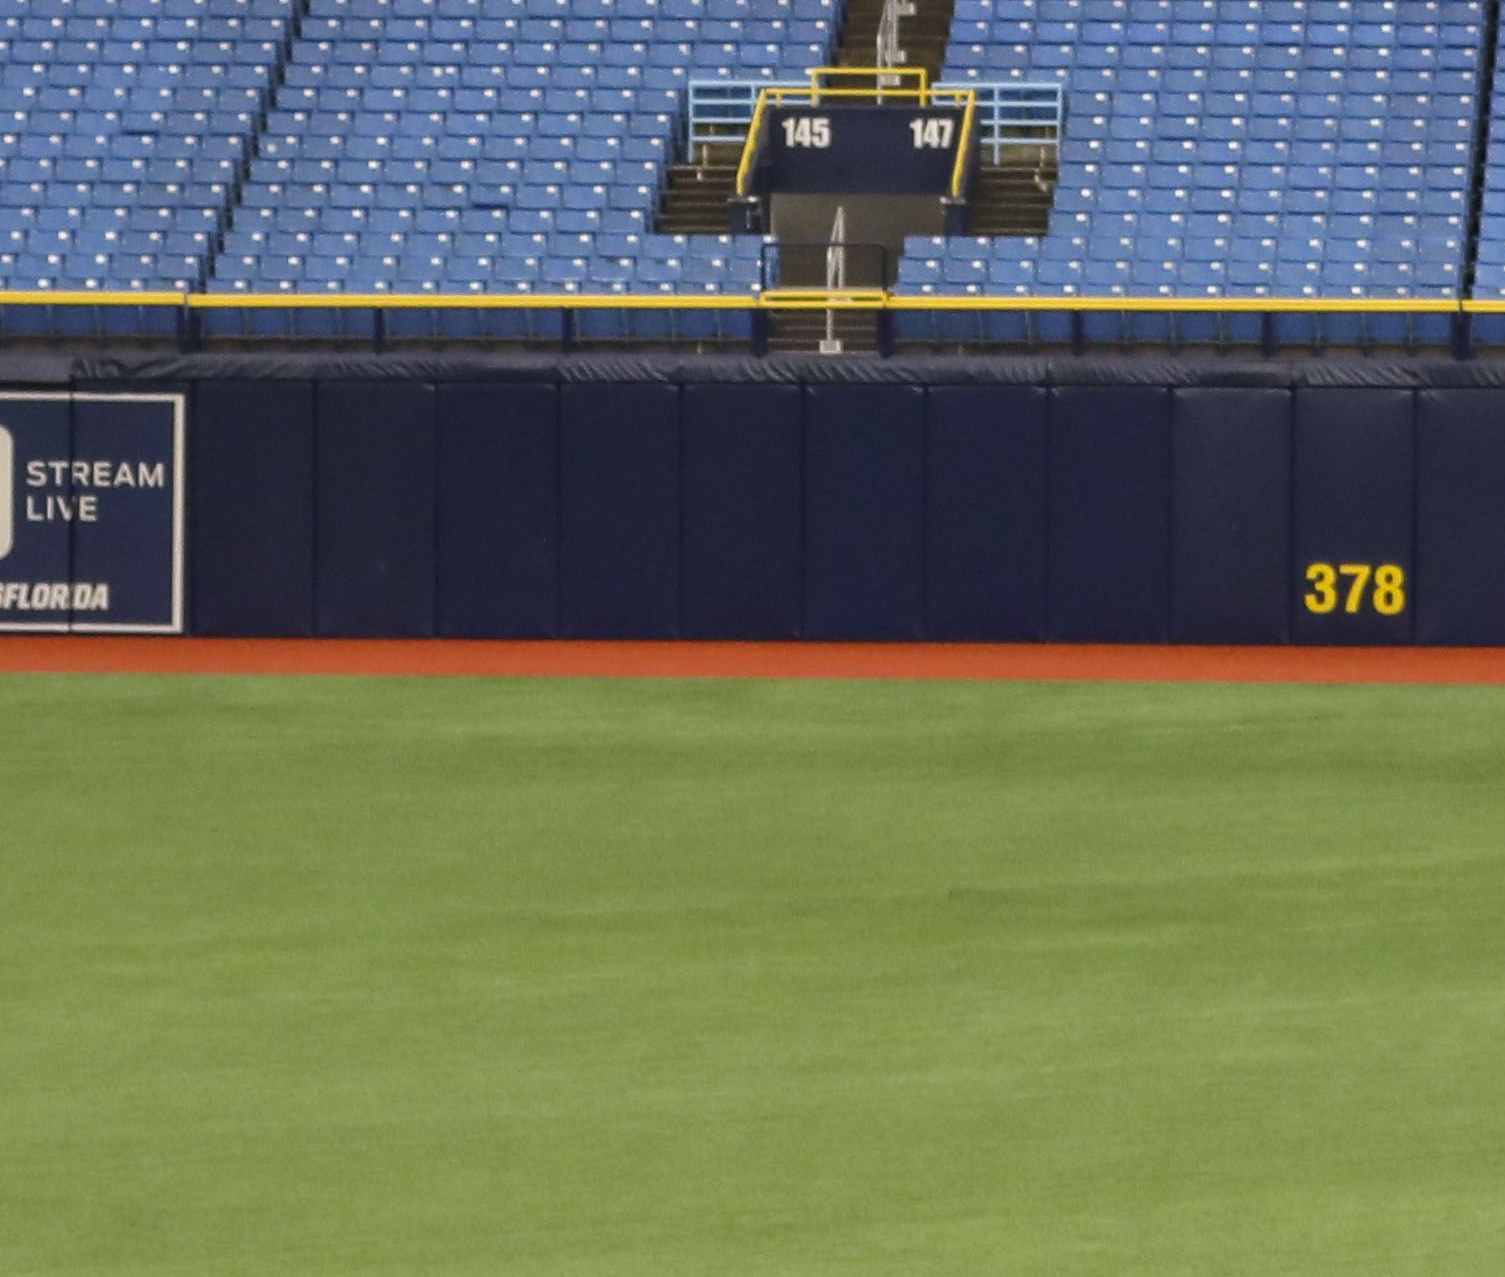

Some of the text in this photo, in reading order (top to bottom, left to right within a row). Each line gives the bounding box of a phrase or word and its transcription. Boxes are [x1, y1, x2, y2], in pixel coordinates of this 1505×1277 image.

[782, 118, 831, 148] 145
[909, 119, 954, 149] 147
[27, 460, 165, 490] STREAM
[27, 495, 98, 522] LIVE
[1304, 564, 1406, 616] 378
